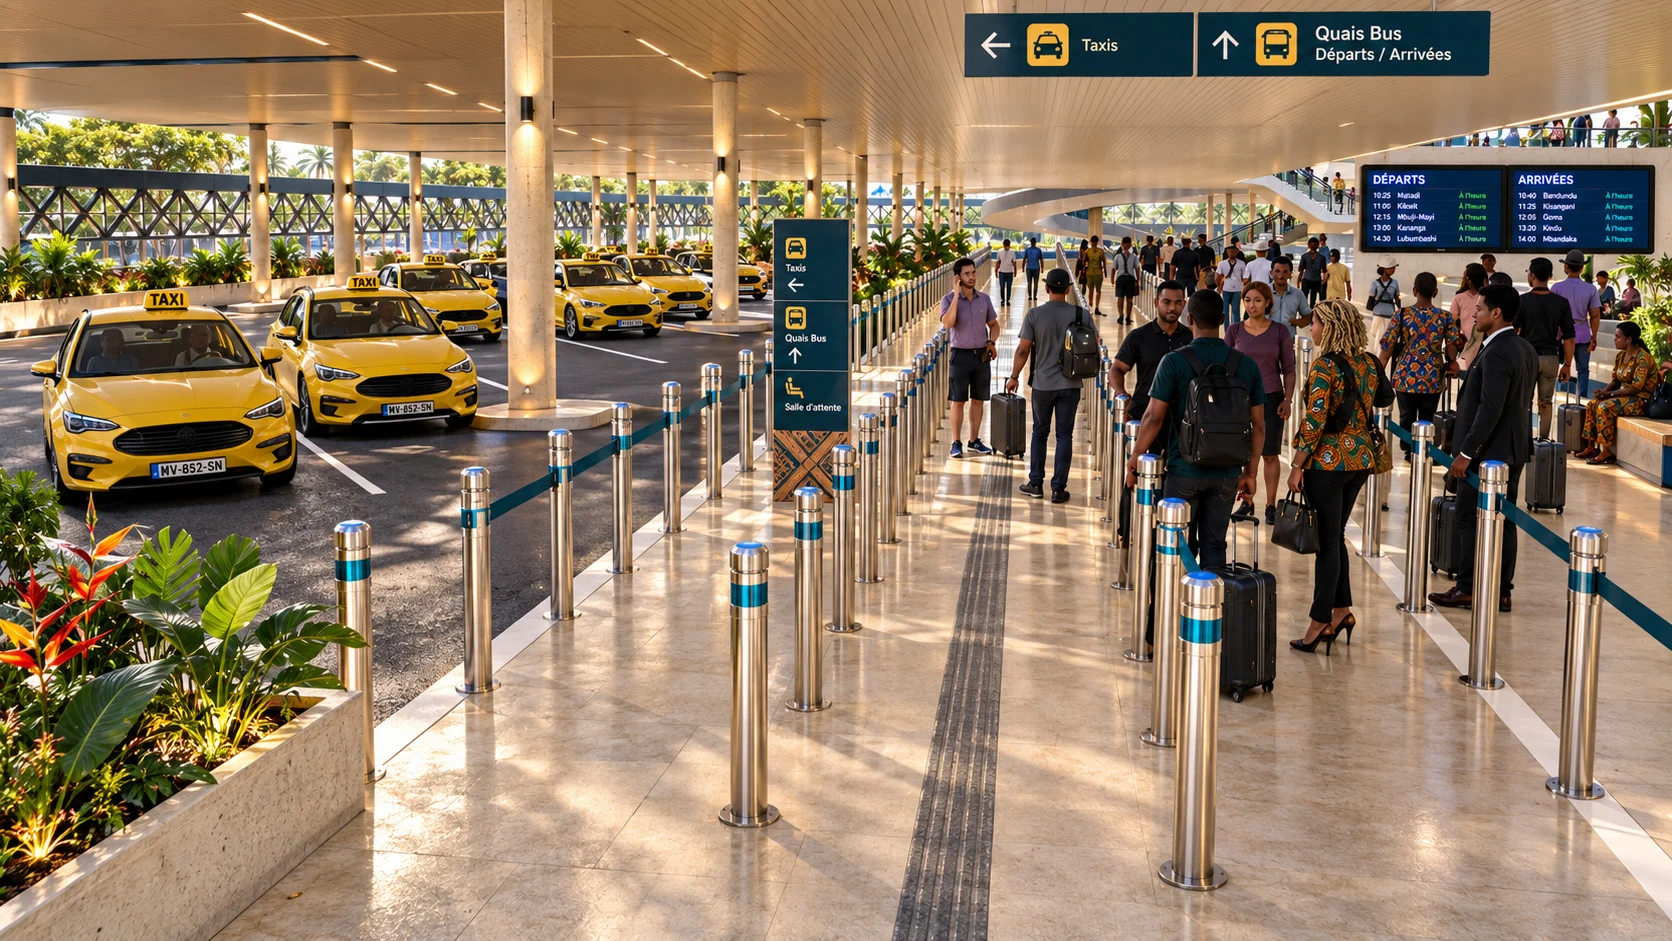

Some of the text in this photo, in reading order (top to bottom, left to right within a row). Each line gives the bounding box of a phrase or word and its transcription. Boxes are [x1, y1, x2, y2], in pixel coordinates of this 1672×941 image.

[1315, 25, 1402, 42] Quais Bus
[1081, 38, 1118, 52] Taxis
[1315, 46, 1452, 65] Départs / Arrivées
[1372, 172, 1426, 185] DÉPARTS
[1517, 172, 1574, 185] ARRIVÉES
[785, 263, 807, 273] Taxis
[352, 276, 377, 288] TAXI
[149, 292, 184, 306] TAXI
[784, 333, 827, 343] Quais Bus
[387, 403, 433, 416] MV-852-SN
[784, 402, 842, 412] Salle d'attente
[160, 459, 223, 477] MV-852-SN
